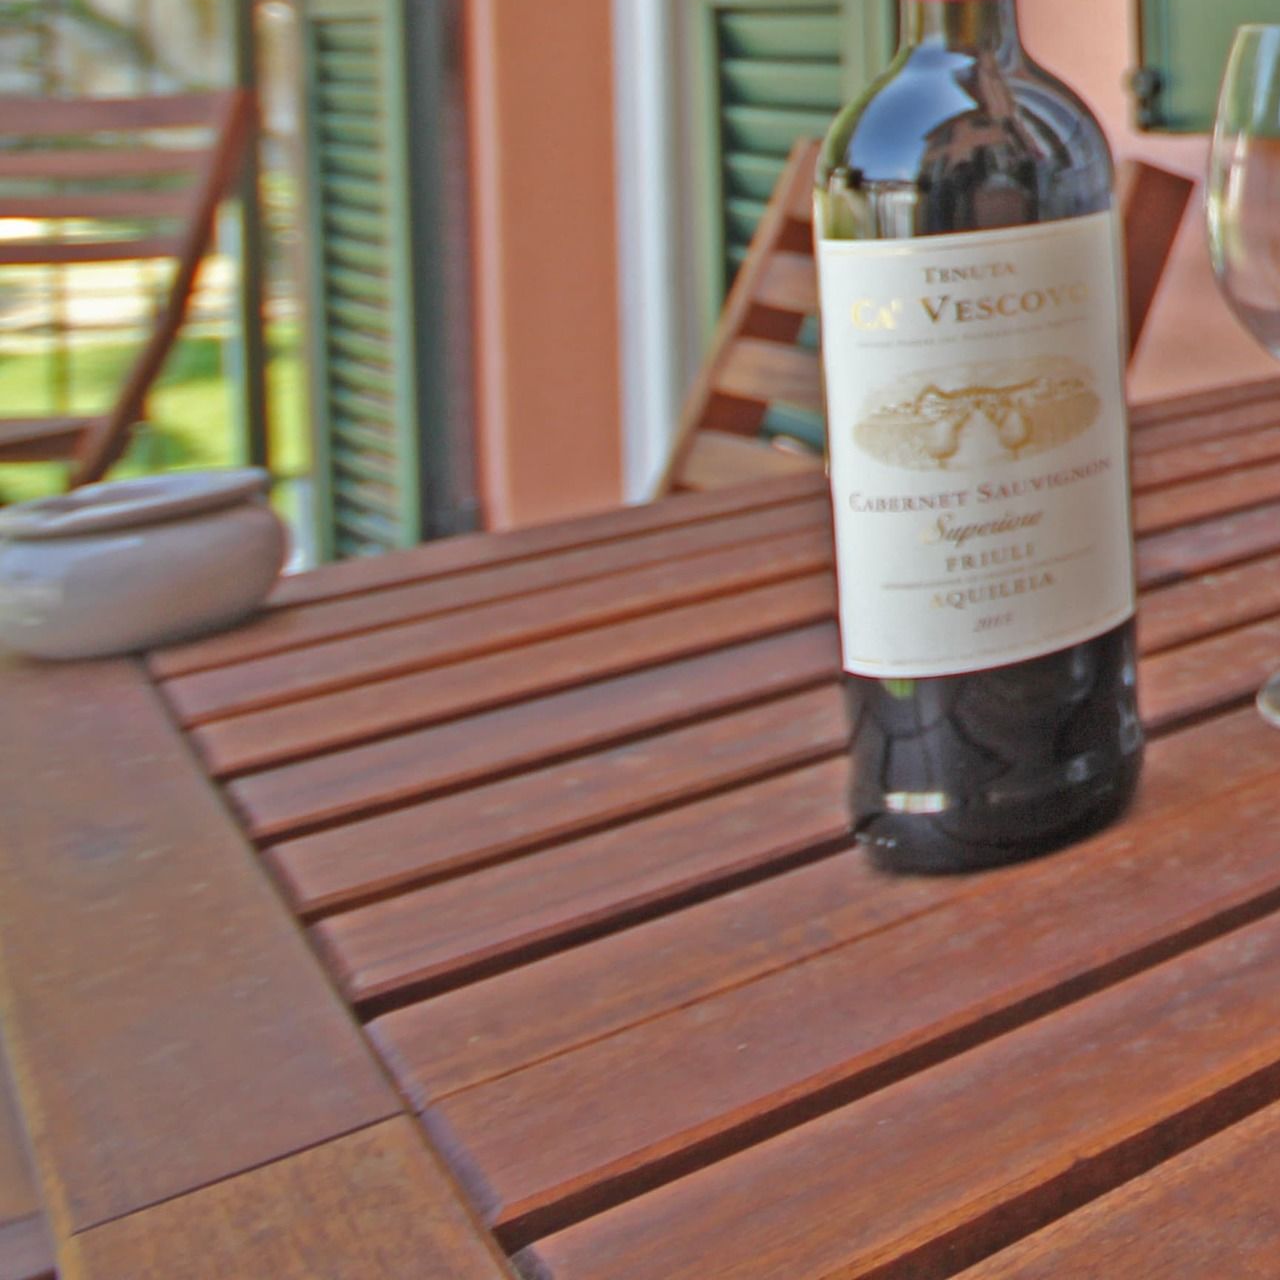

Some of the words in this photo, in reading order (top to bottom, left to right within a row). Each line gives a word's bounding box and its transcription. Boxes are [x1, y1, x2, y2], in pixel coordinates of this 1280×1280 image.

[923, 262, 1017, 285] TENUTA
[920, 283, 1089, 324] VESCOVO
[849, 490, 968, 513] CABERNET
[977, 459, 1111, 504] SAUVIGNON
[946, 543, 1035, 572] FRIULI
[931, 571, 1054, 609] AQUILEIA
